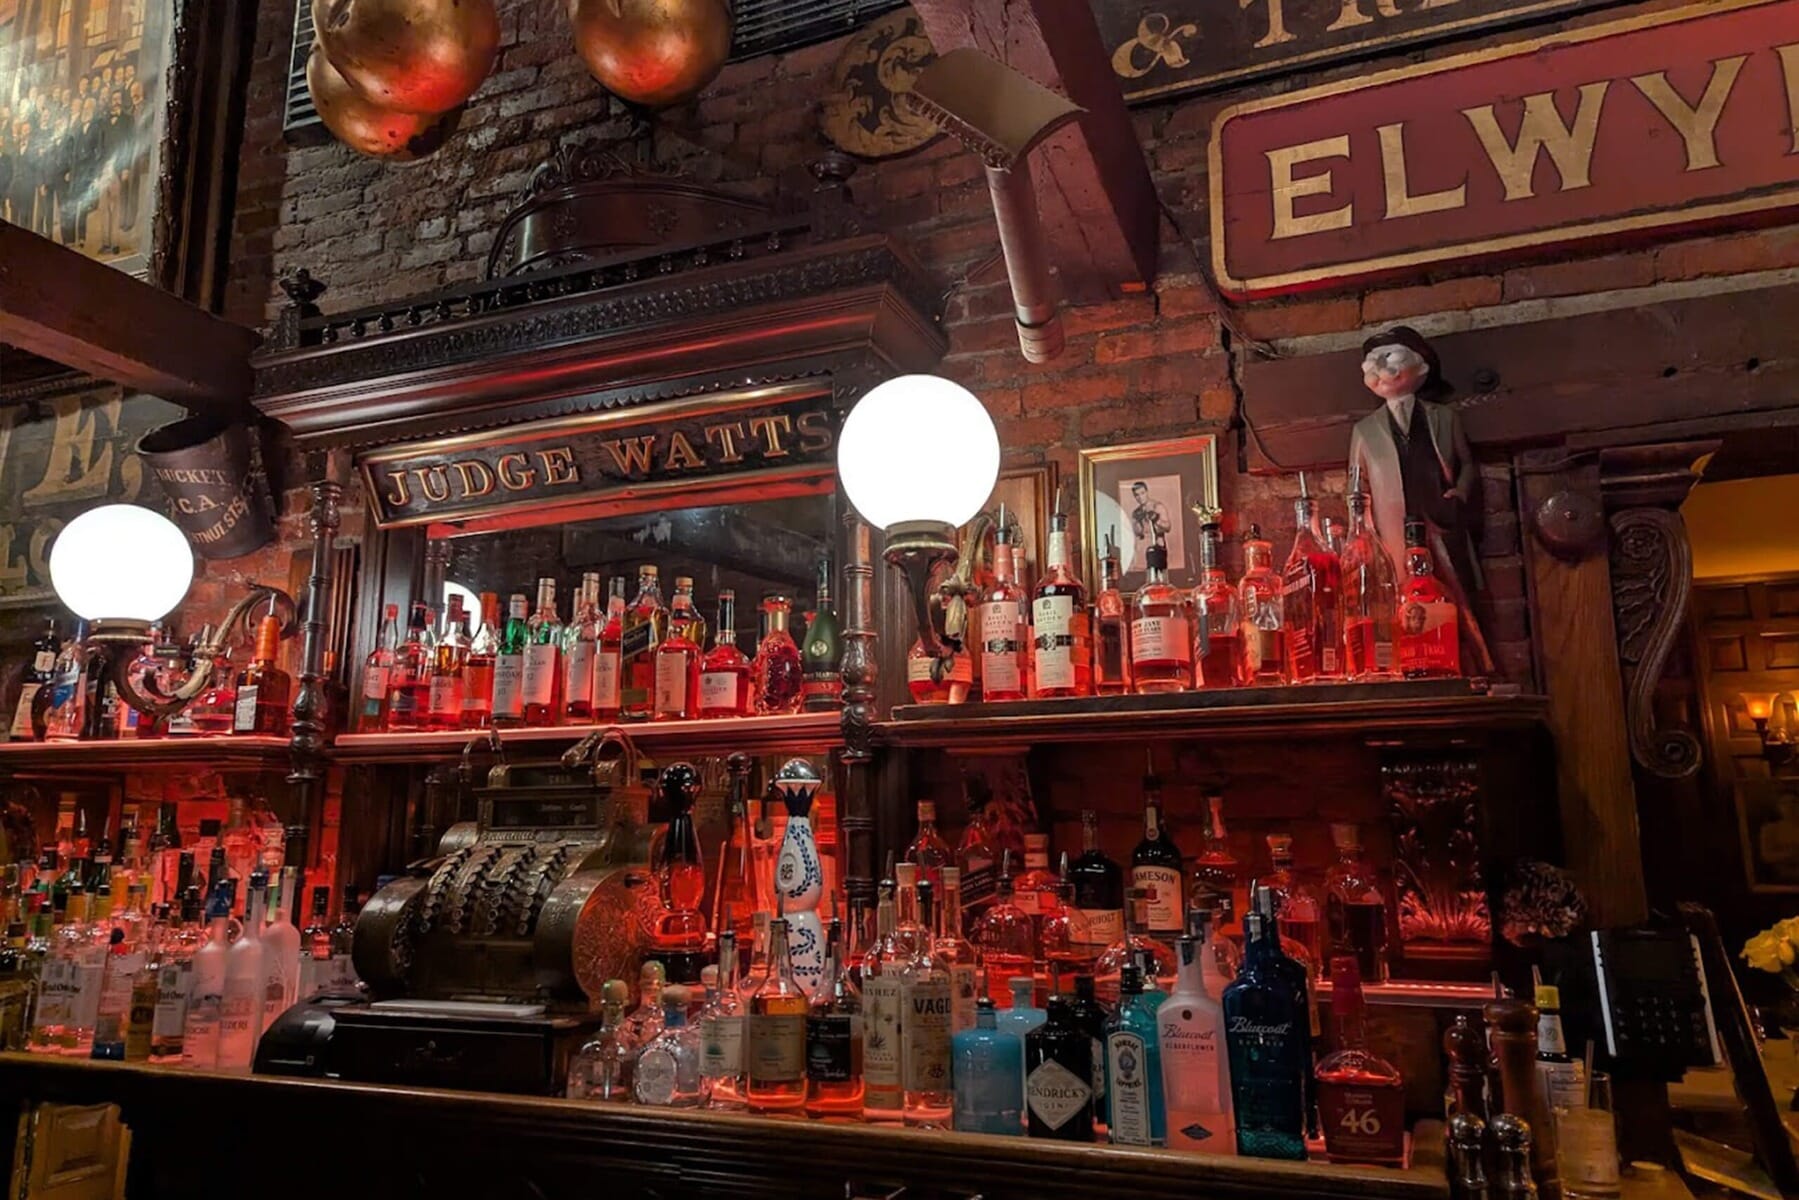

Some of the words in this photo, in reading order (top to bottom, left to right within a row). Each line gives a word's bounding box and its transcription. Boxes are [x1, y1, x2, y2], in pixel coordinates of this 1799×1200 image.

[1265, 46, 1799, 241] ELWY
[387, 446, 581, 507] JUDGE
[604, 410, 835, 476] WATTS
[1134, 870, 1176, 885] AMESON
[1162, 1024, 1217, 1041] Bluecoat
[1229, 1015, 1292, 1035] Bluecoat
[1340, 1107, 1381, 1135] 46
